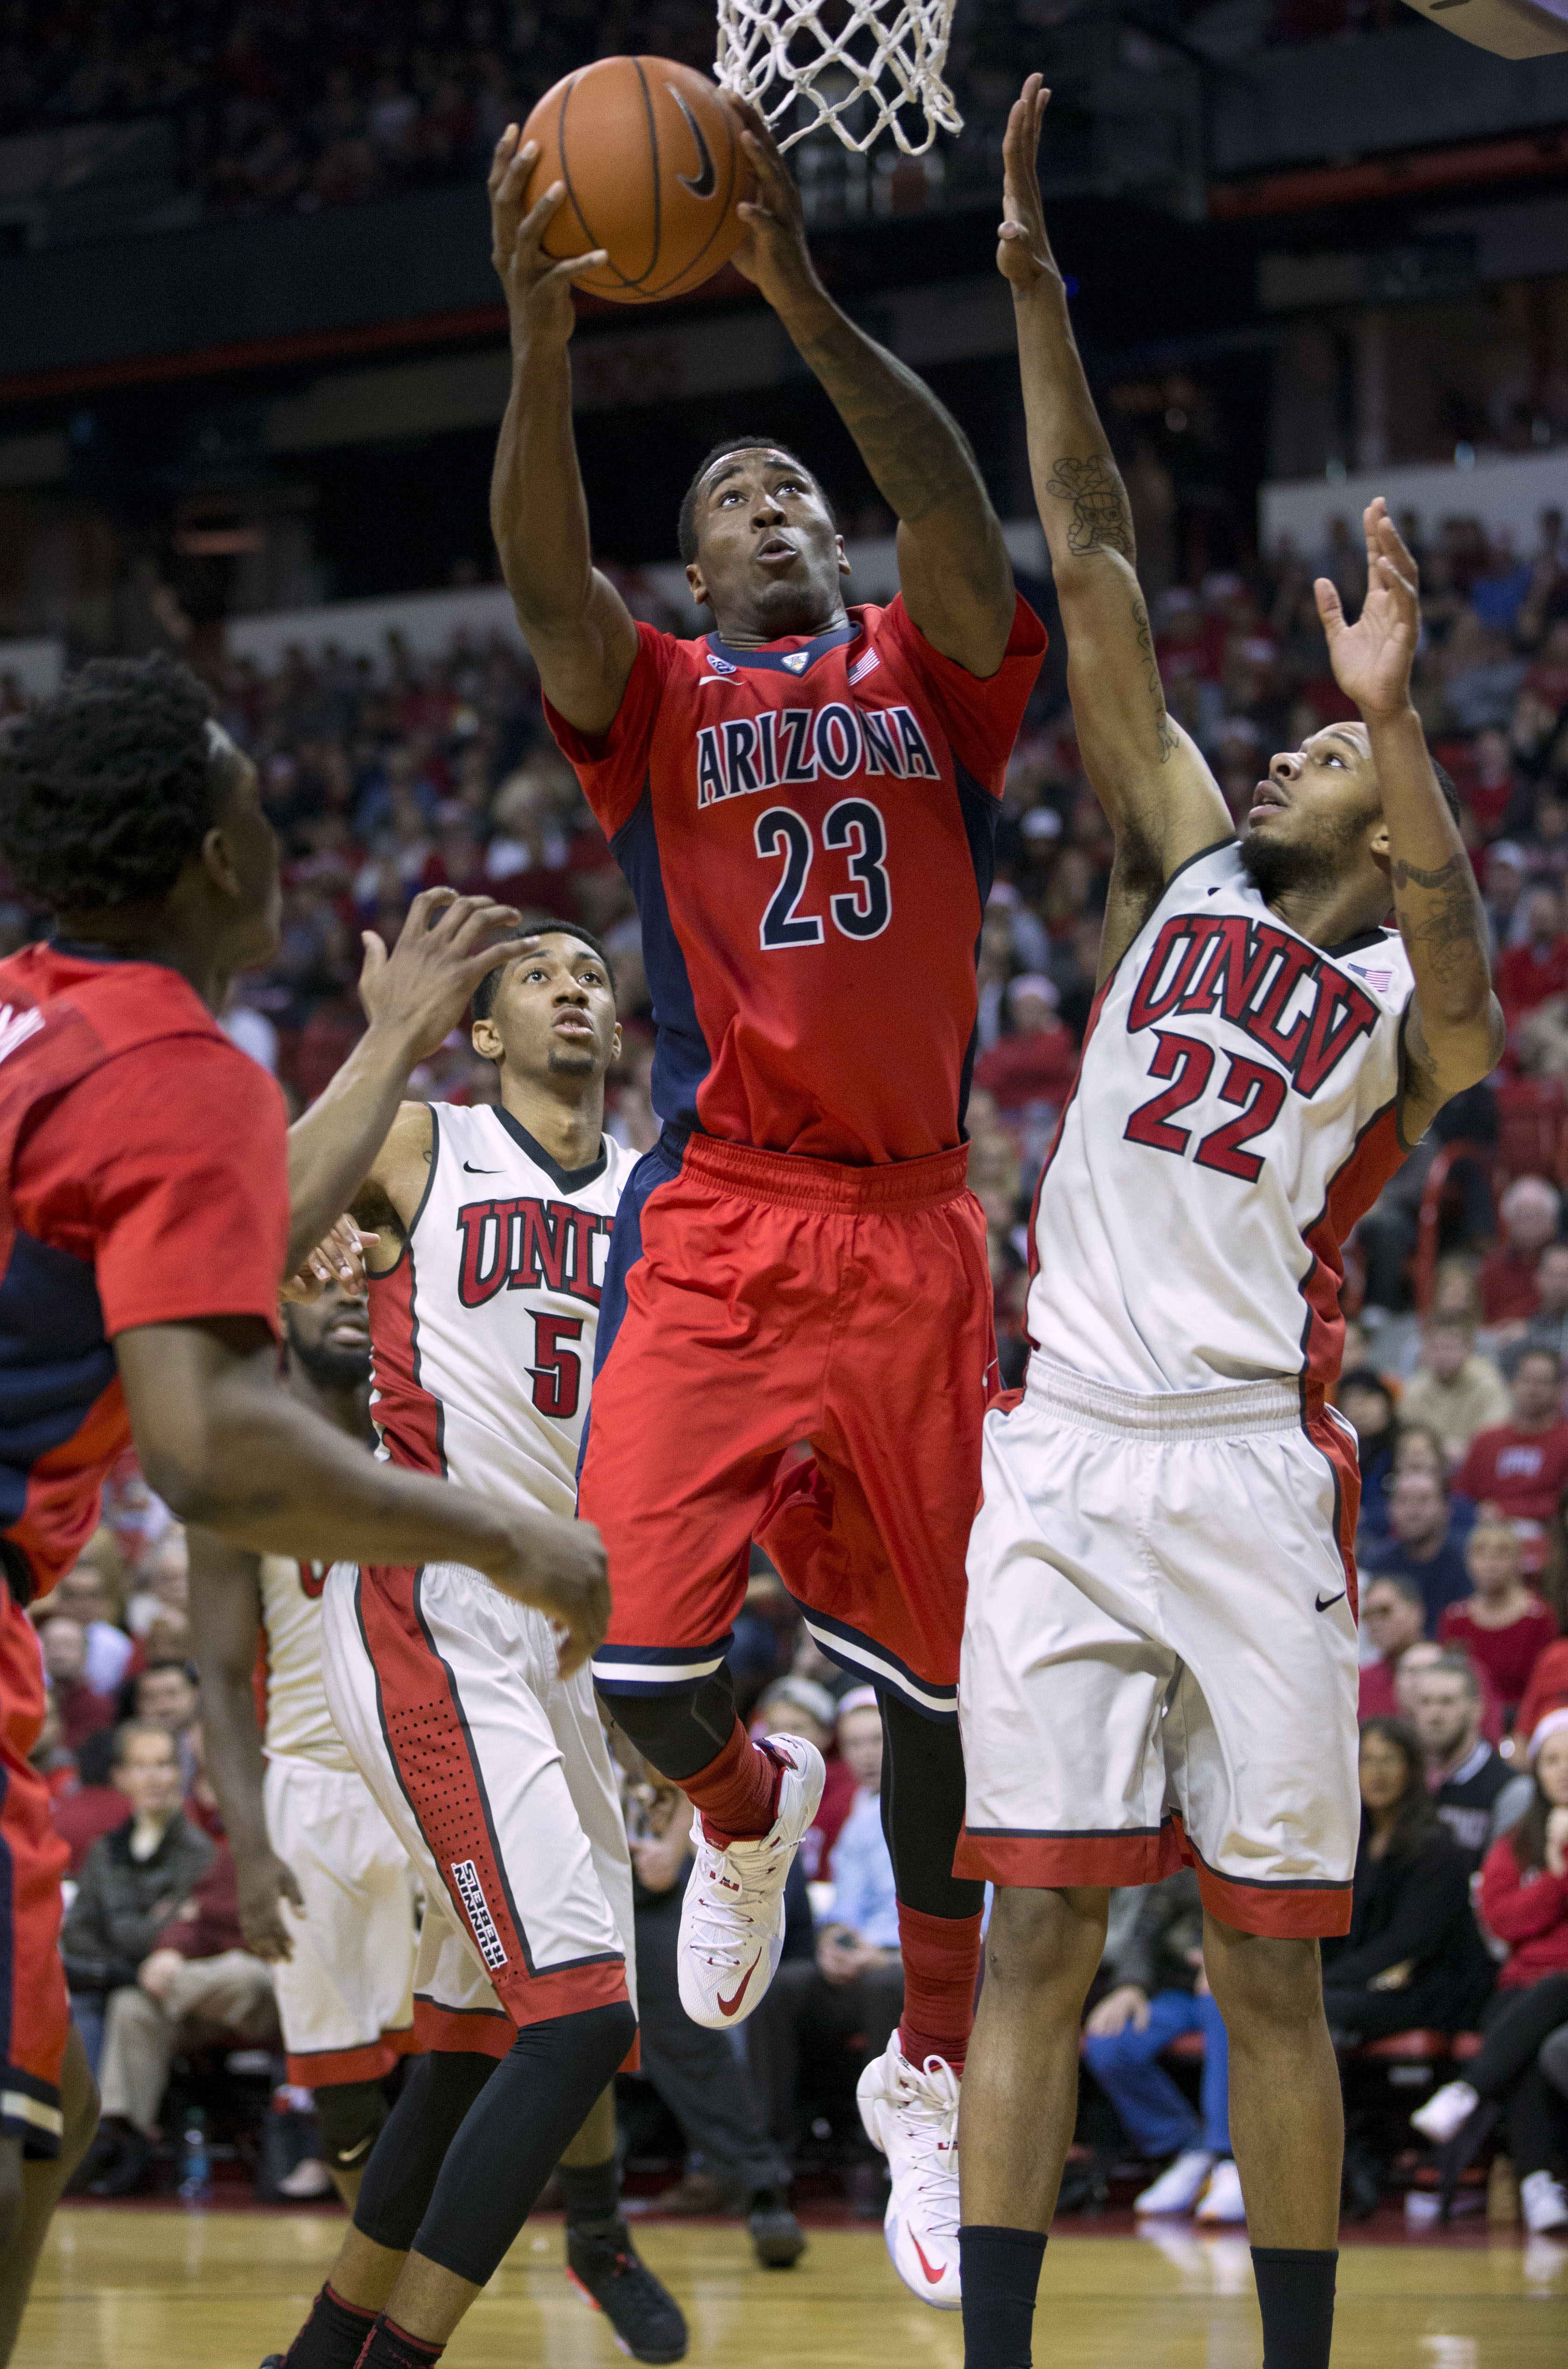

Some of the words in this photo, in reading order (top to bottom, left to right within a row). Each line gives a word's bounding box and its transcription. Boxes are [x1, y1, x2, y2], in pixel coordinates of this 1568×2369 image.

[697, 702, 941, 810] ARIZONA
[754, 797, 892, 950] 23
[1127, 913, 1381, 1100] UNLV
[1123, 1027, 1288, 1184] 22
[456, 1197, 616, 1309] UNL
[524, 1308, 584, 1419] 5
